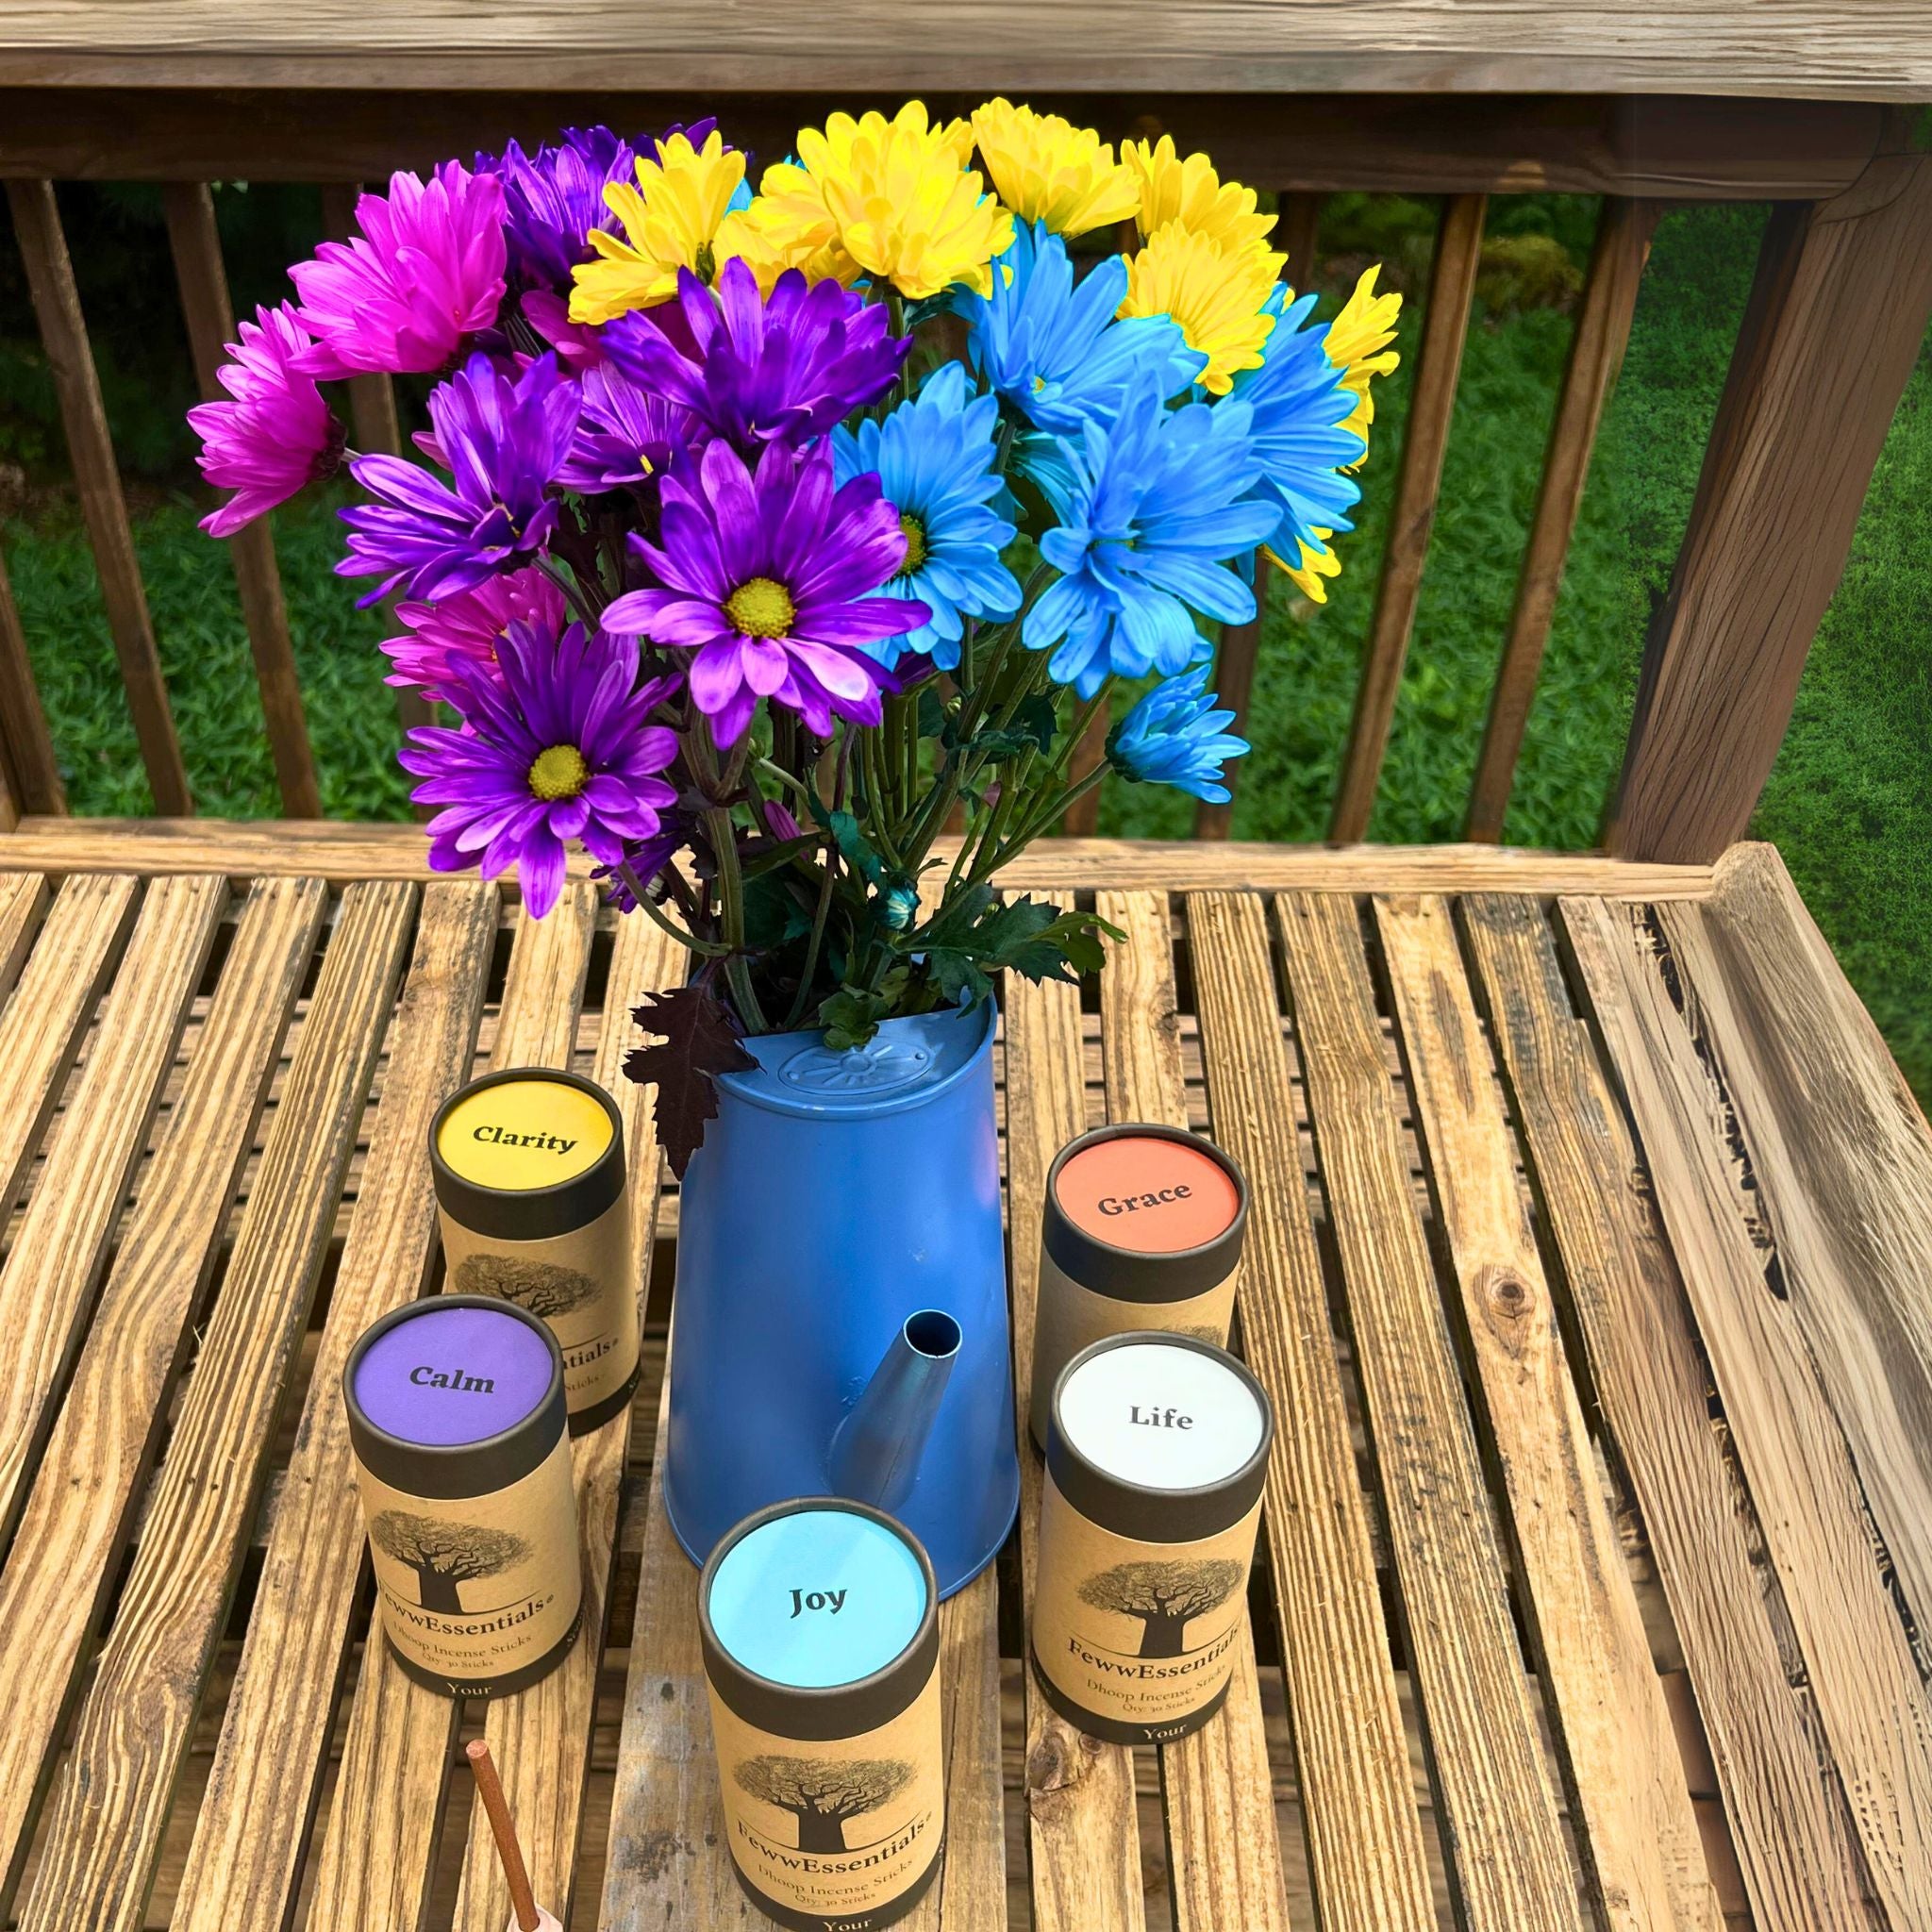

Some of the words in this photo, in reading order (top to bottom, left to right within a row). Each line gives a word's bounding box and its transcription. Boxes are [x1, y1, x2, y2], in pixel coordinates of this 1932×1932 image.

[473, 1125, 578, 1156] Clarity
[1097, 1182, 1192, 1216] Grace
[409, 1366, 494, 1394] Calm
[1129, 1406, 1194, 1430] Life
[789, 1588, 848, 1619] Joy
[434, 1644, 486, 1658] Incense
[491, 1636, 531, 1655] Sticks
[446, 1682, 492, 1696] Your
[1087, 1678, 1135, 1703] Dhoop
[1140, 1688, 1192, 1703] Incense
[1143, 1724, 1188, 1740] Your
[738, 1819, 924, 1874] FewwEssentials
[810, 1884, 869, 1896] Incense
[874, 1860, 912, 1887] Sticks
[823, 1919, 872, 1932] Your
